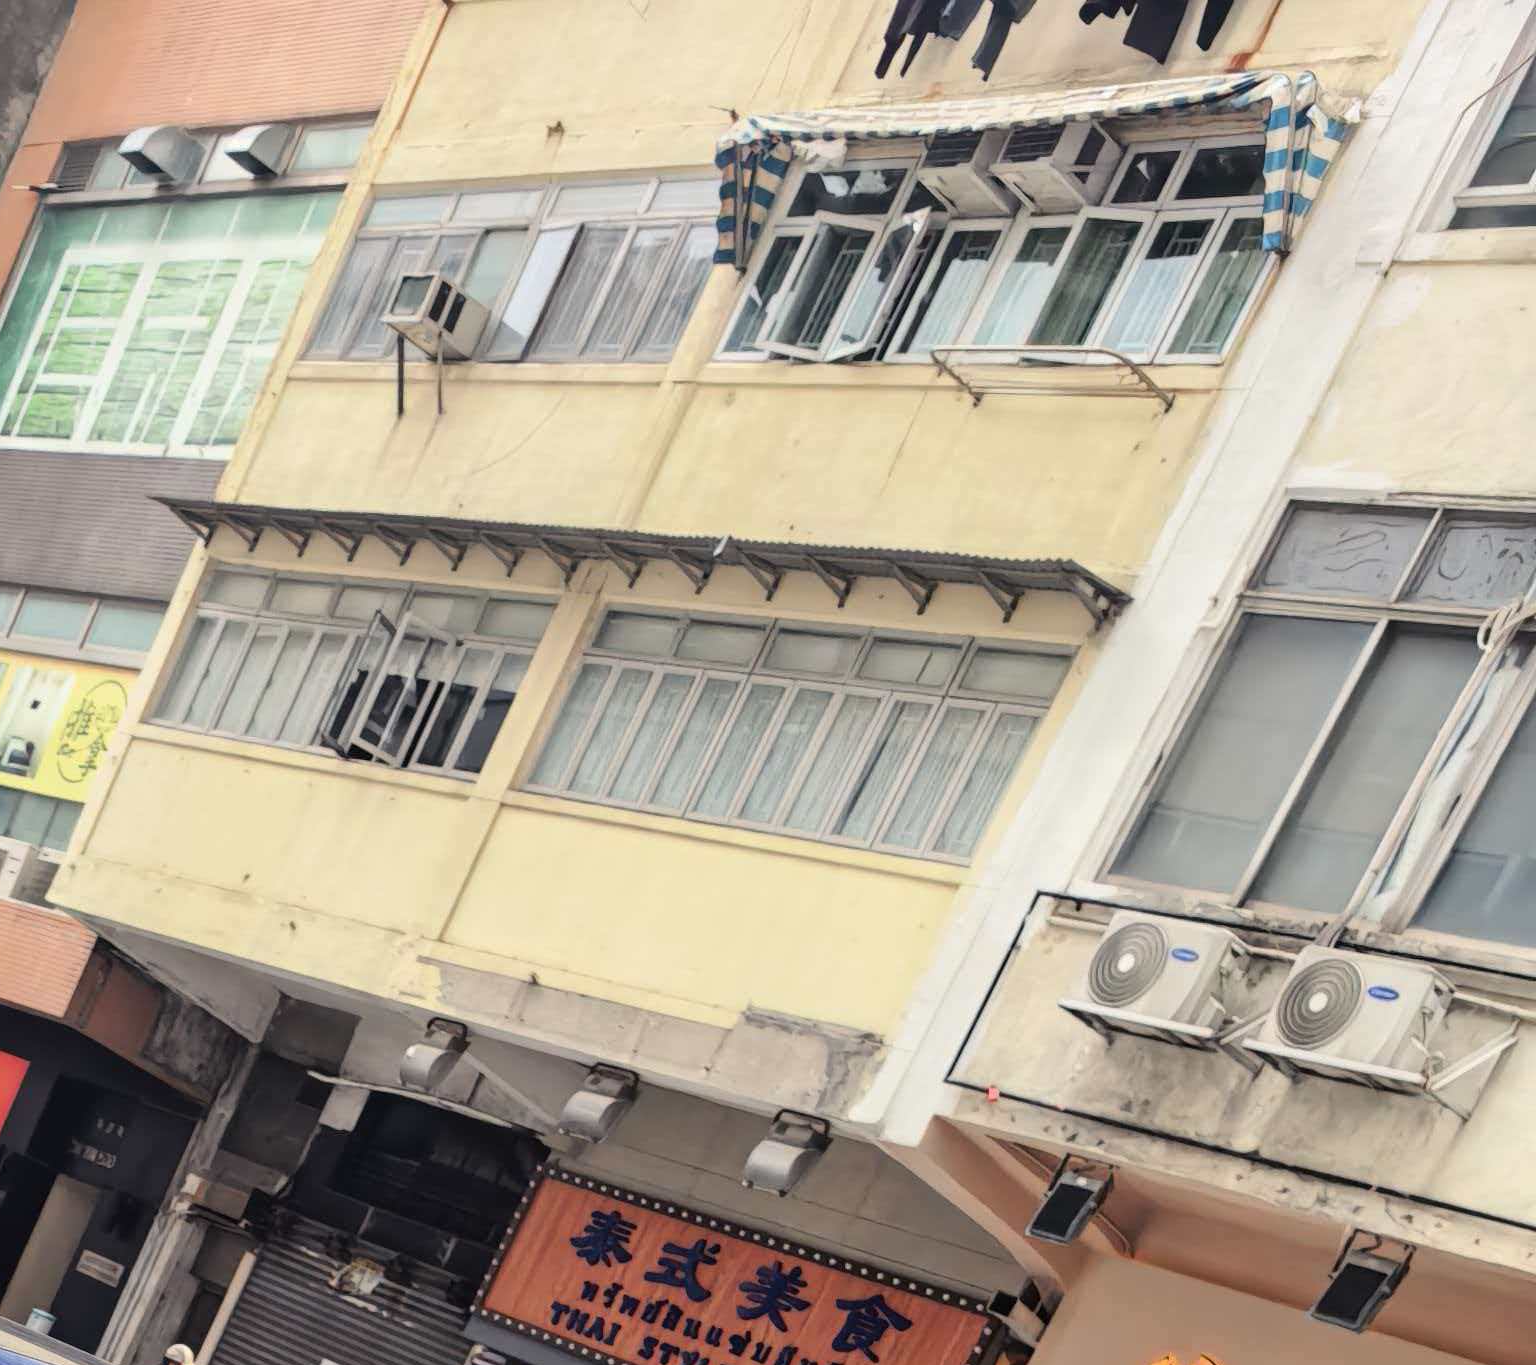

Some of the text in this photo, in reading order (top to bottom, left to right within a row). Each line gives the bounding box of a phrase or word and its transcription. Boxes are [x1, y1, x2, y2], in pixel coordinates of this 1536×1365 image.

[549, 1300, 623, 1347] THAI
[570, 1209, 913, 1364] 泰式美食
